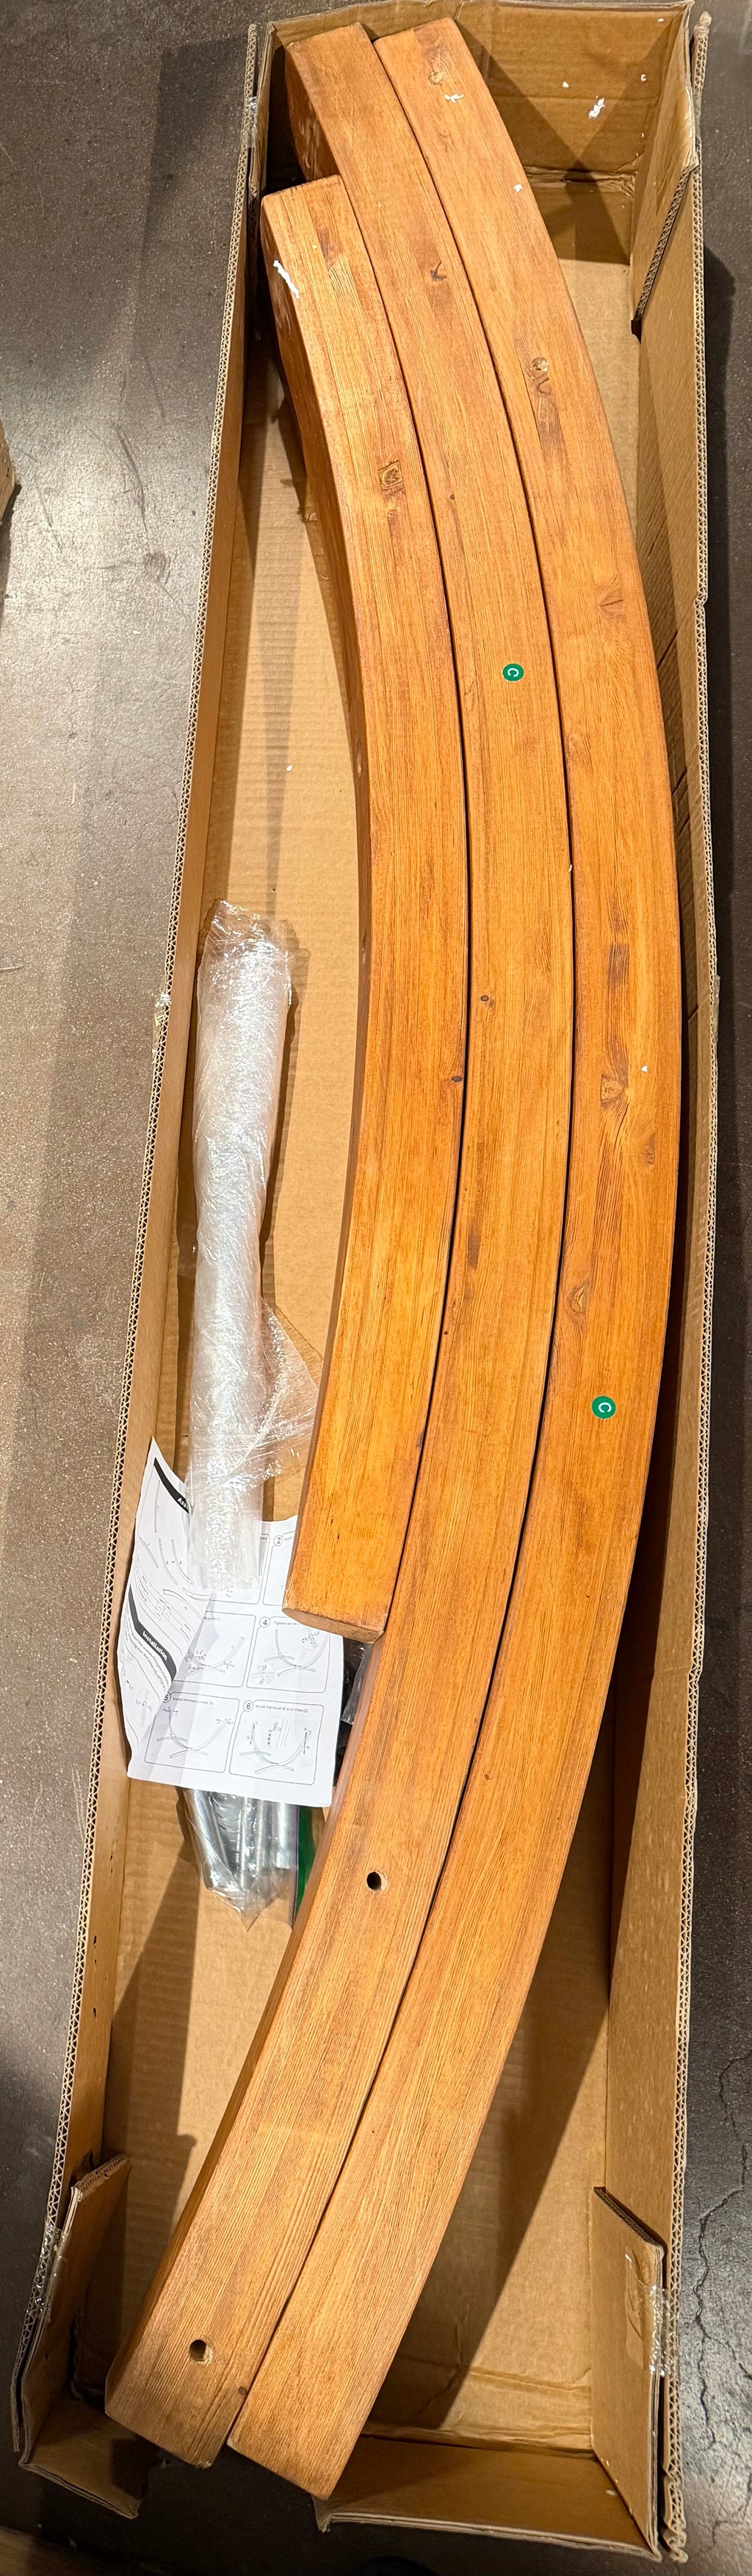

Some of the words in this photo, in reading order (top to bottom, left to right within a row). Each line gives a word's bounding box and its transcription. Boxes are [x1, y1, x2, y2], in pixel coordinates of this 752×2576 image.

[507, 667, 519, 677] C
[598, 1402, 612, 1413] C
[142, 1630, 167, 1660] Installation
